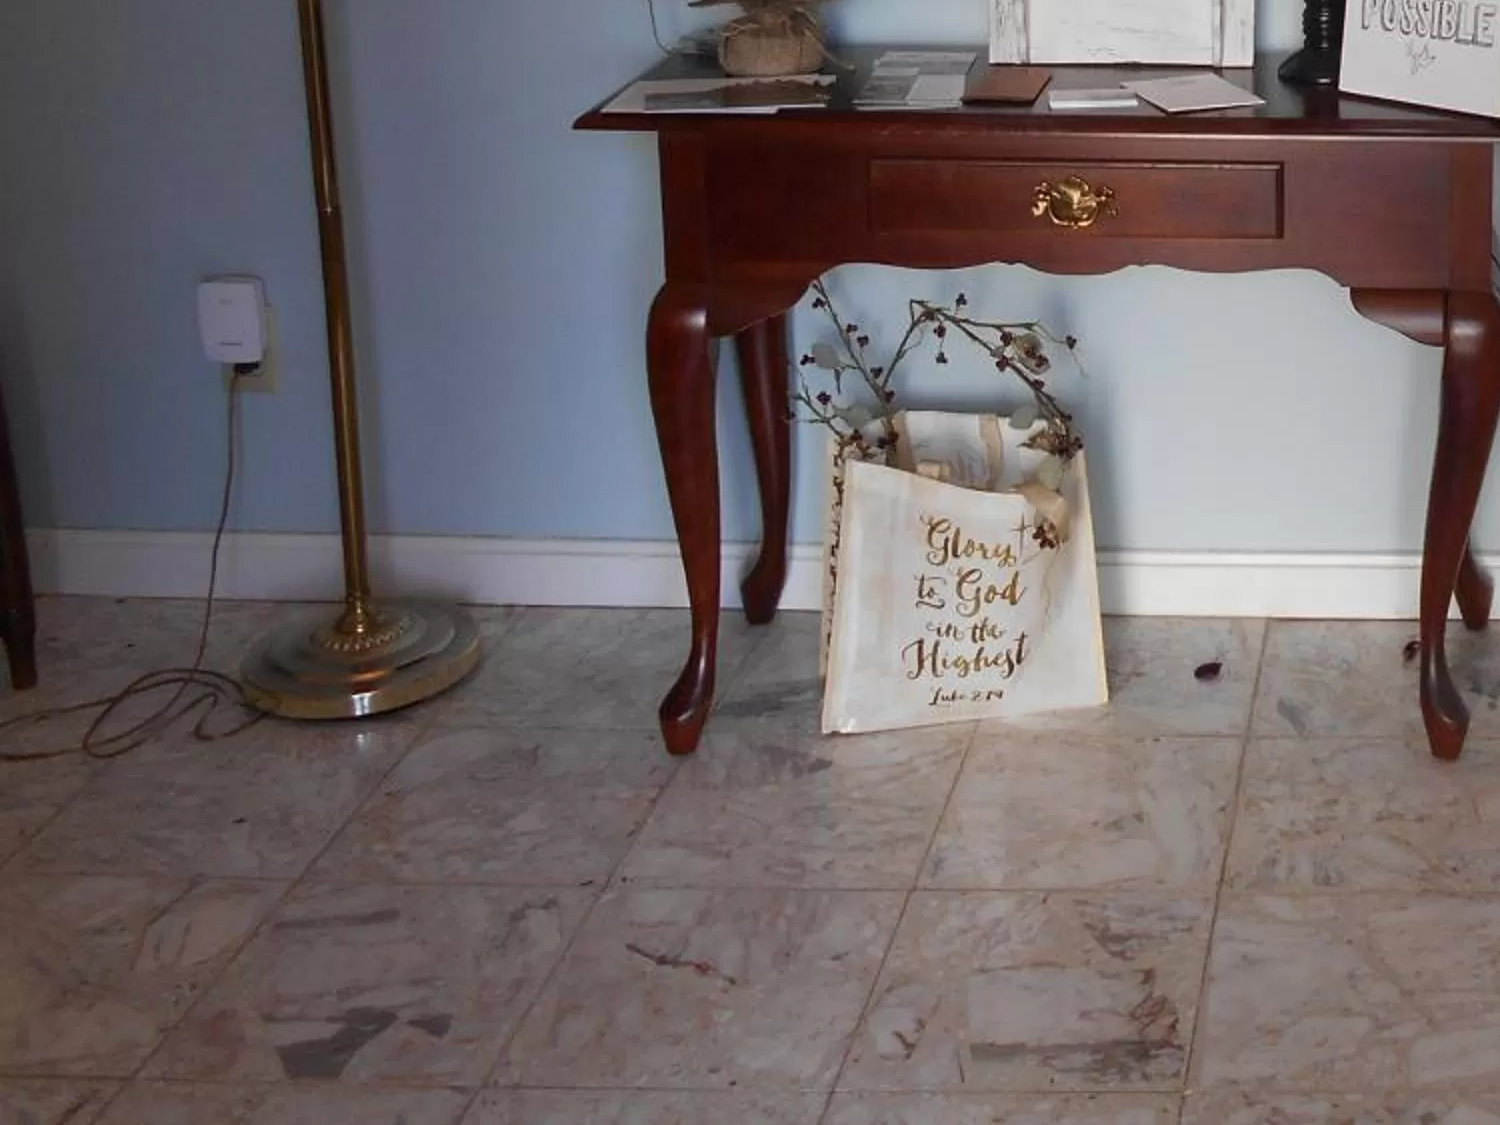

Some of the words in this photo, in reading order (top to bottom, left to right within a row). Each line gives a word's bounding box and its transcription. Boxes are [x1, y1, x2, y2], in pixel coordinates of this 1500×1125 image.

[920, 514, 1017, 566] Glory
[914, 574, 947, 603] to
[955, 567, 1028, 617] God
[926, 621, 964, 641] in
[966, 616, 1007, 643] the
[902, 631, 1028, 680] Highest
